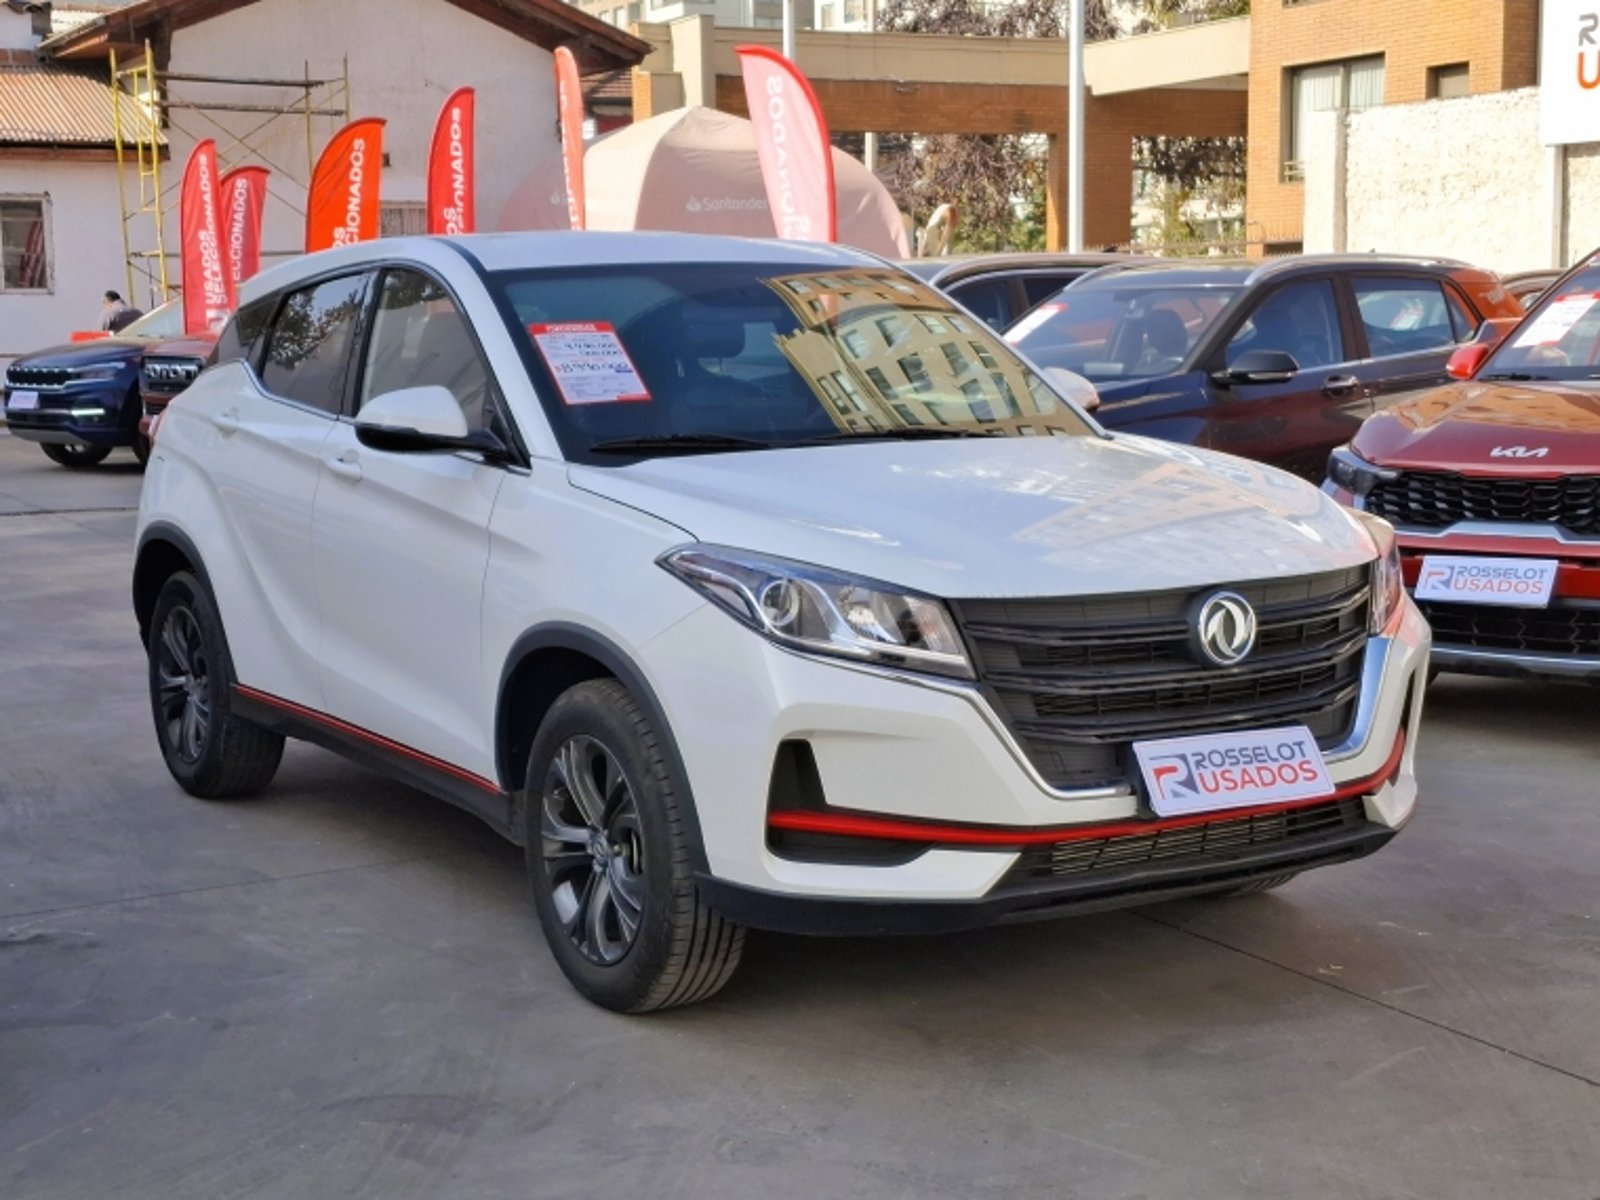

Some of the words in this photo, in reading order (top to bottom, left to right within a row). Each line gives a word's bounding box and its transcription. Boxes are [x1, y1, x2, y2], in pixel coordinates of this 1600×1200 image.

[197, 229, 215, 304] USADOS
[1490, 446, 1549, 458] KIA
[1456, 565, 1548, 581] ROSSELOT
[1453, 578, 1543, 595] USADOS
[1191, 740, 1306, 771] ROSSELOT
[1198, 760, 1319, 794] USADOS
